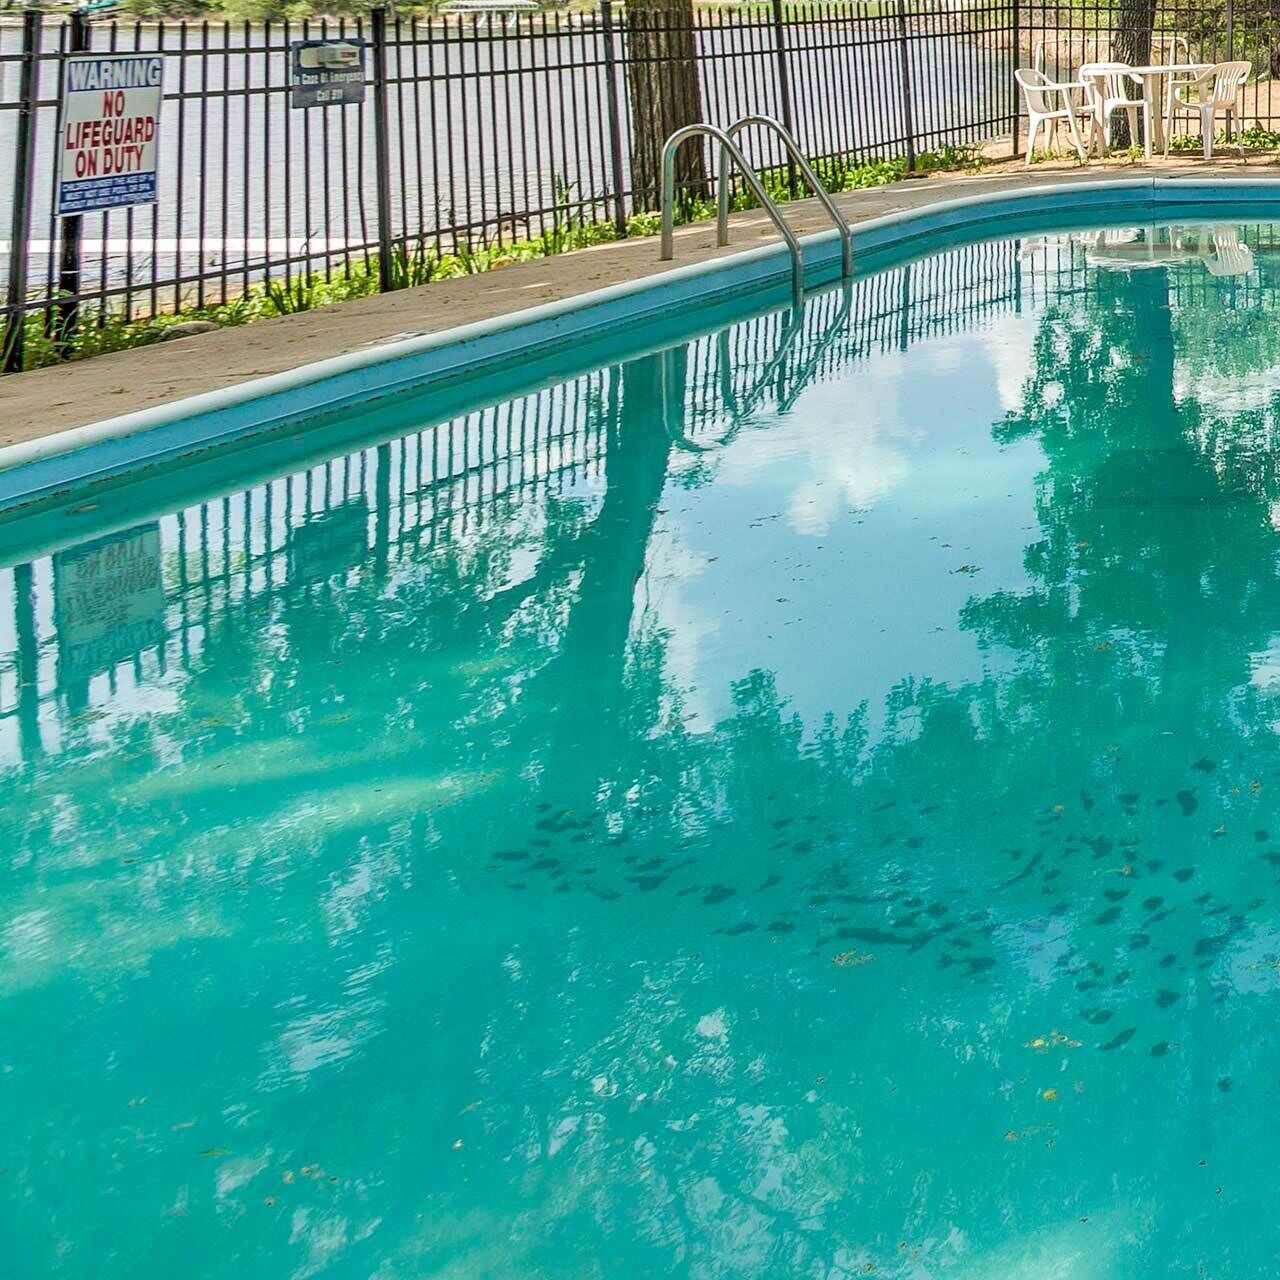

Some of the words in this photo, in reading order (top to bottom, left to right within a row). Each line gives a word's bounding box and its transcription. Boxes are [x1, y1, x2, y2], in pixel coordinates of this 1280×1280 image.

[70, 59, 161, 90] WARNING
[103, 90, 125, 118] NO
[66, 116, 155, 149] LIFEGUARD
[75, 149, 97, 178] ON
[103, 144, 144, 174] DUTY
